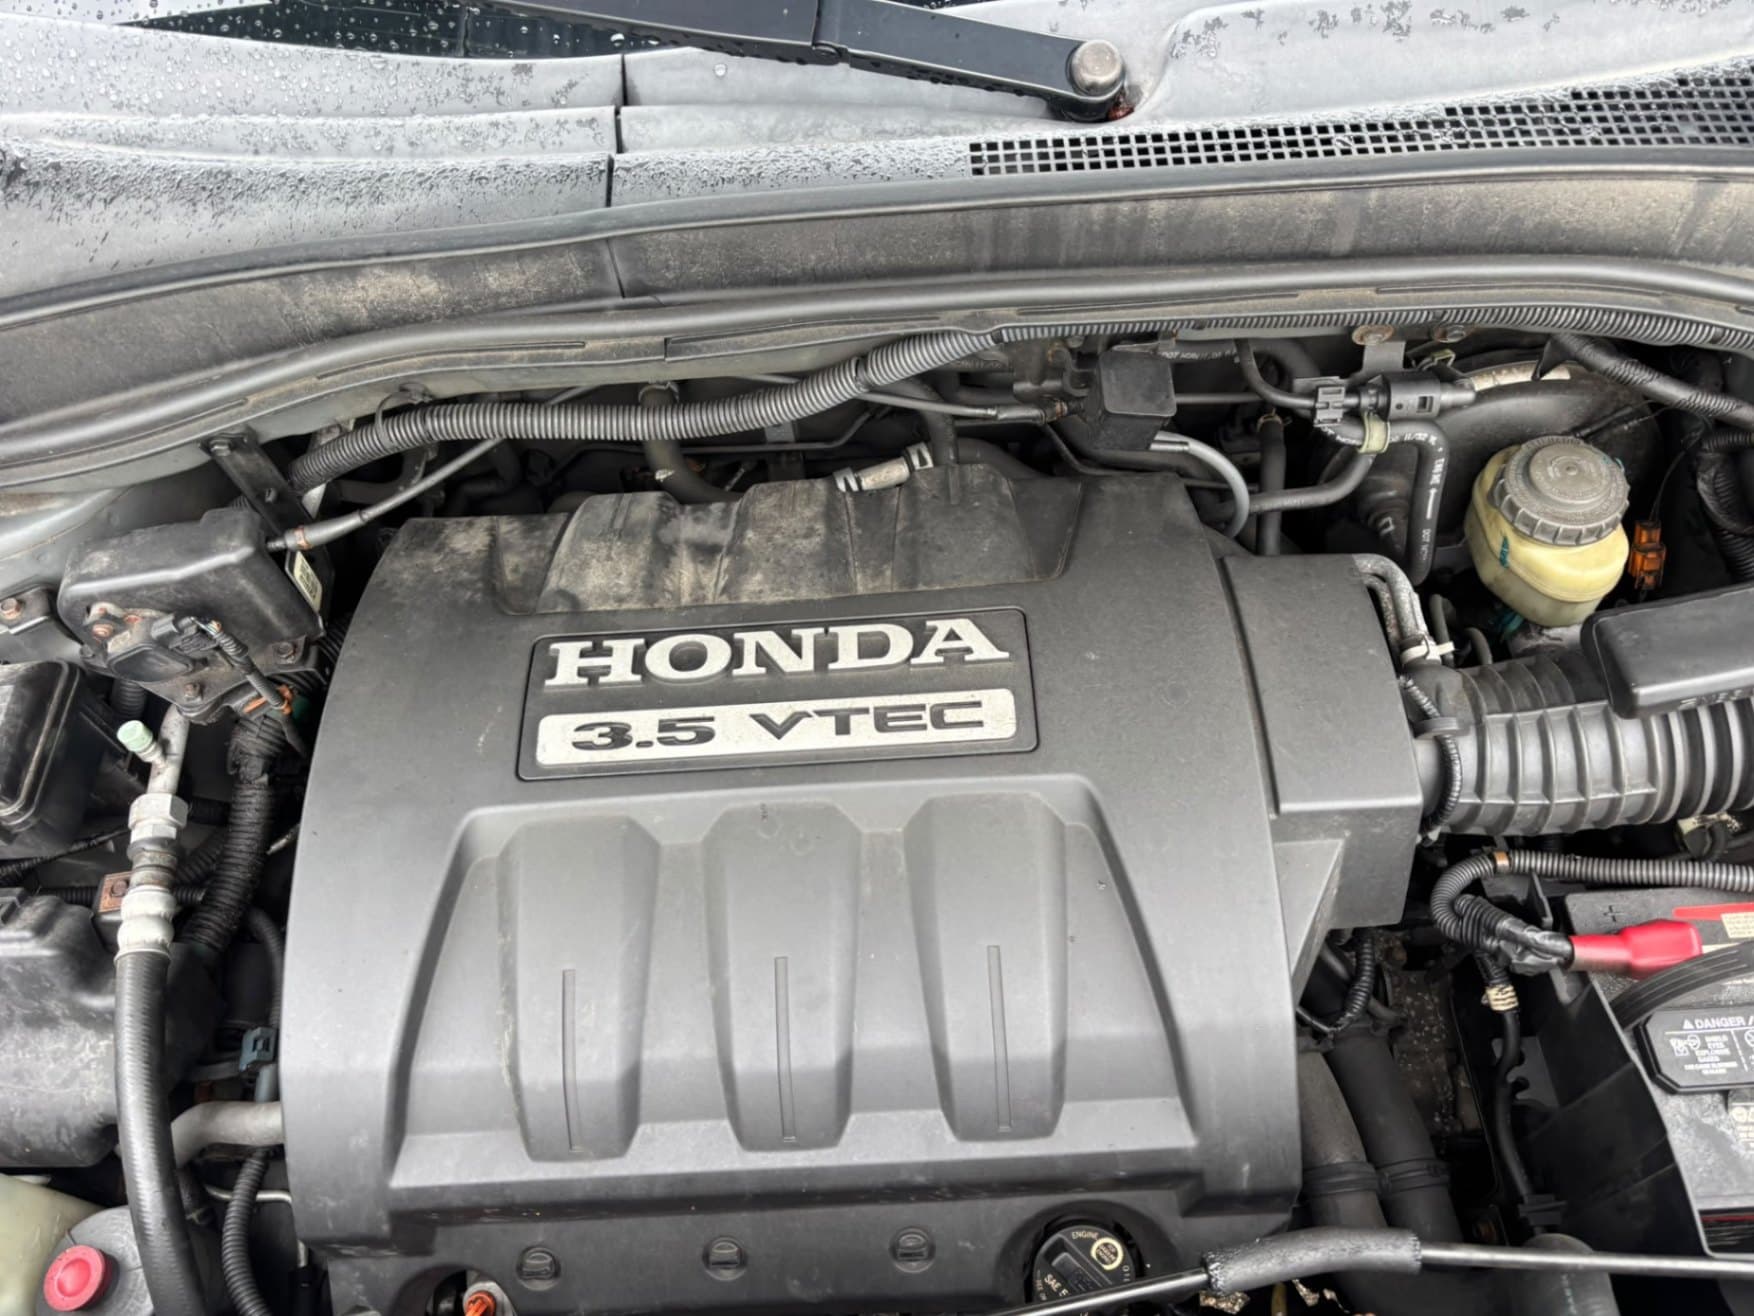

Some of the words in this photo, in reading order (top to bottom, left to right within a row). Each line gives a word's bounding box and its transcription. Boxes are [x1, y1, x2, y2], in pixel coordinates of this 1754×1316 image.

[544, 617, 1010, 687] HONDA
[571, 716, 717, 751] 3.5
[748, 701, 985, 740] VTEC
[1694, 1016, 1746, 1029] DANGER
[1071, 1230, 1099, 1240] ENGINE
[1044, 1273, 1061, 1292] SAE
